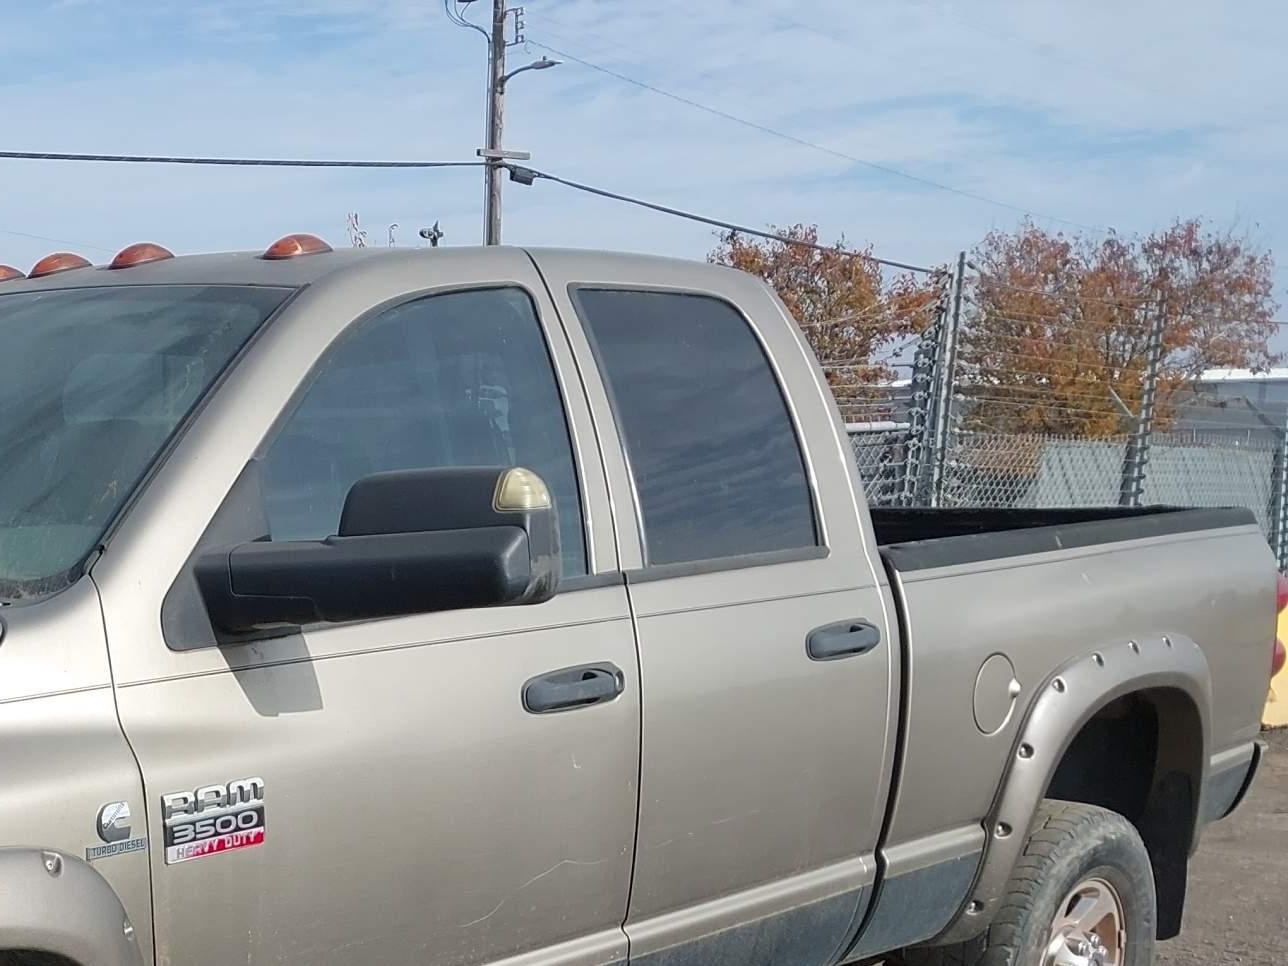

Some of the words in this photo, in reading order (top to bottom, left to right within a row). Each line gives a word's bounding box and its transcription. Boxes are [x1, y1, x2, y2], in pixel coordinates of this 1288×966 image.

[161, 777, 265, 820] RAM
[173, 810, 258, 844] 3500
[92, 844, 118, 857] TURBO
[119, 839, 145, 852] DIESEL
[176, 838, 219, 859] HEAVY
[224, 832, 257, 849] DUTY
